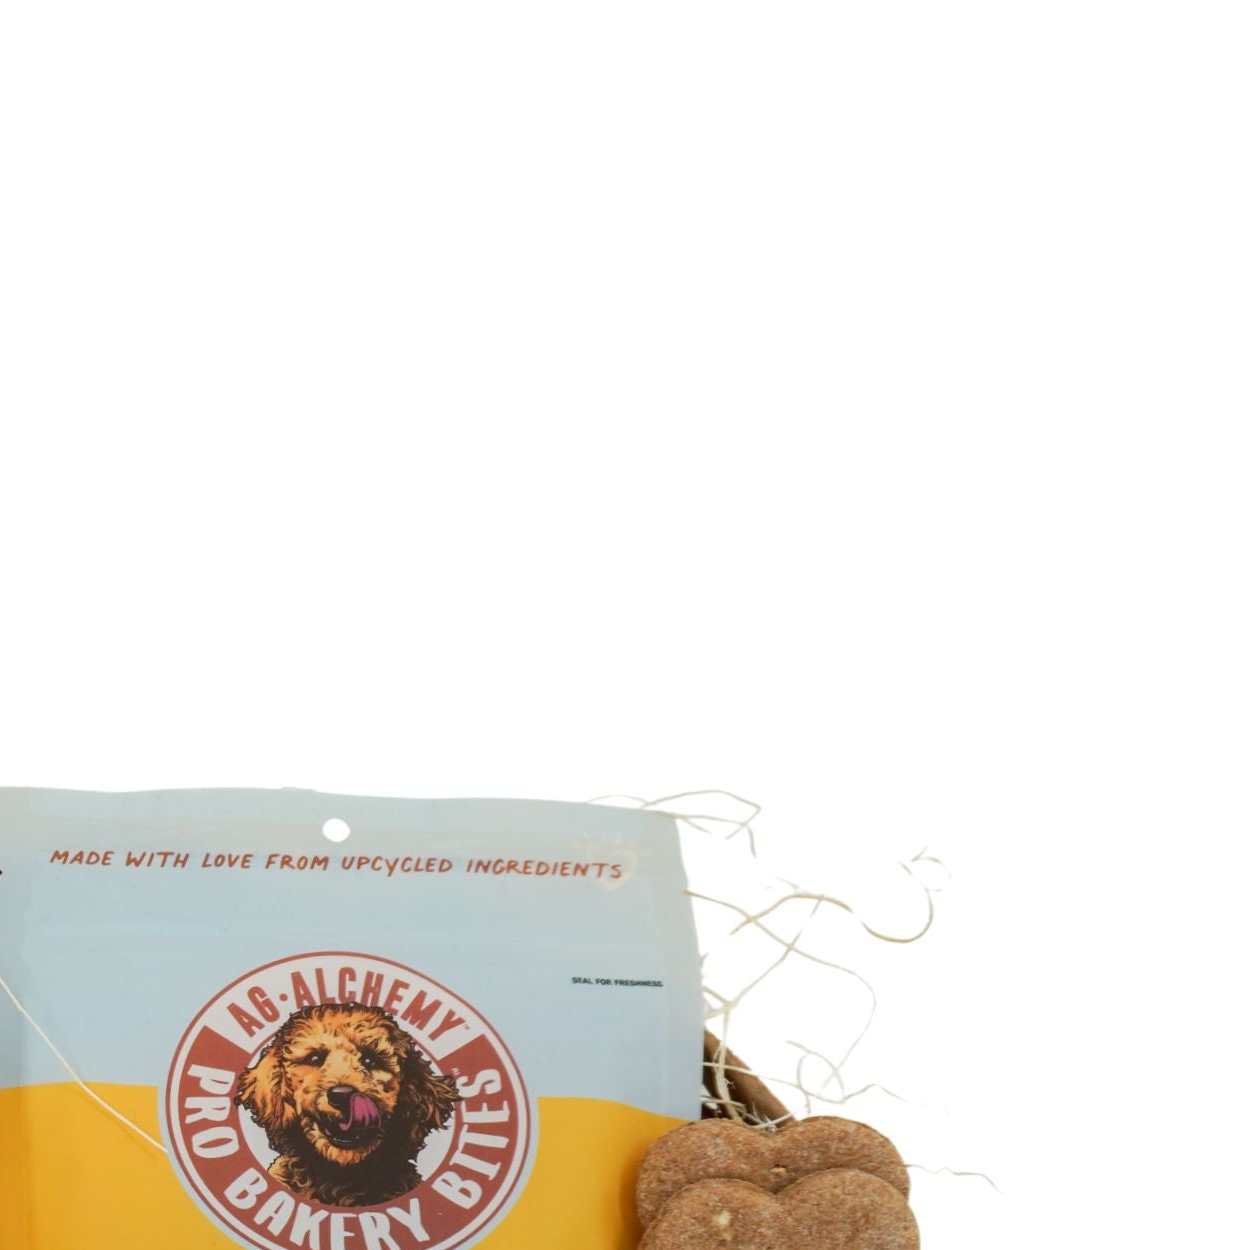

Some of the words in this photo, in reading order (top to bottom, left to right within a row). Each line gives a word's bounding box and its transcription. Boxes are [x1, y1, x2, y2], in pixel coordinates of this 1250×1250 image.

[50, 850, 115, 866] MADE
[125, 851, 190, 869] WITH
[201, 852, 254, 870] LOVE
[265, 853, 330, 872] FROM
[341, 855, 454, 878] UPCYCLED
[466, 858, 624, 880] INGREDIENTS
[571, 976, 593, 985] SEAL
[595, 978, 613, 986] FOR
[185, 1064, 240, 1159] PRO
[431, 1067, 511, 1211] BITES
